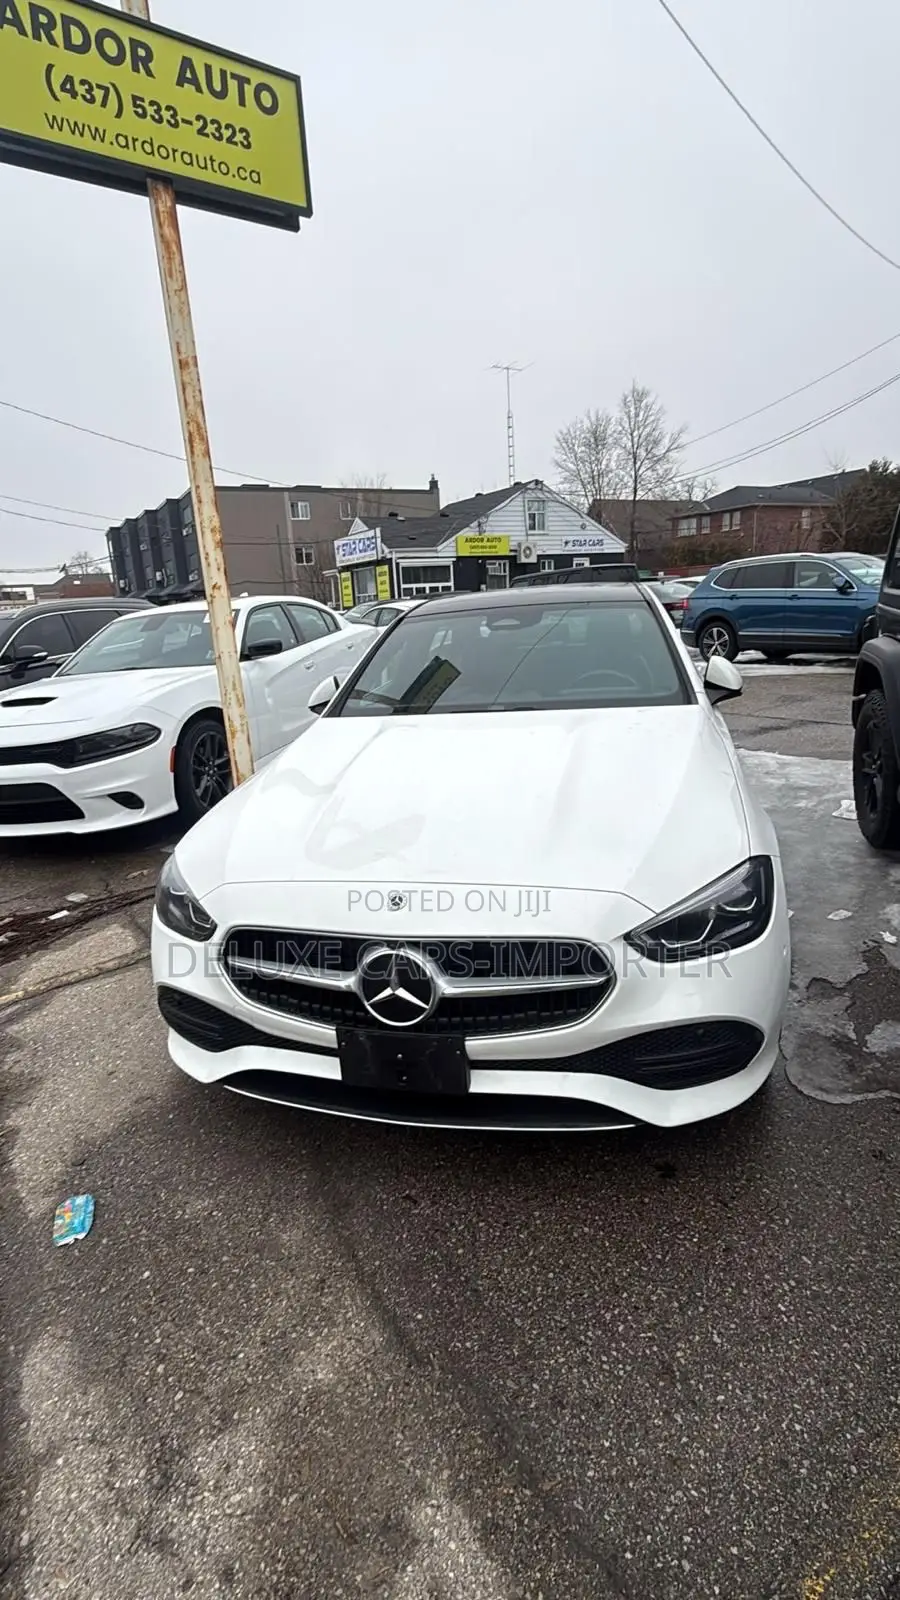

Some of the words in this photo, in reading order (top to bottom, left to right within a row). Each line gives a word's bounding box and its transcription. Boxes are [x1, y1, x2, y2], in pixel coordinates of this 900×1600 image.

[0, 0, 156, 79] ARDOR
[175, 55, 279, 117] AUTO
[45, 63, 124, 118] (437)
[131, 94, 252, 150] 533-2323
[44, 112, 262, 186] www.ardorauto.ca
[342, 540, 357, 557] STAR
[358, 535, 376, 554] CARS
[572, 539, 587, 547] STAR
[588, 538, 604, 547] CARS
